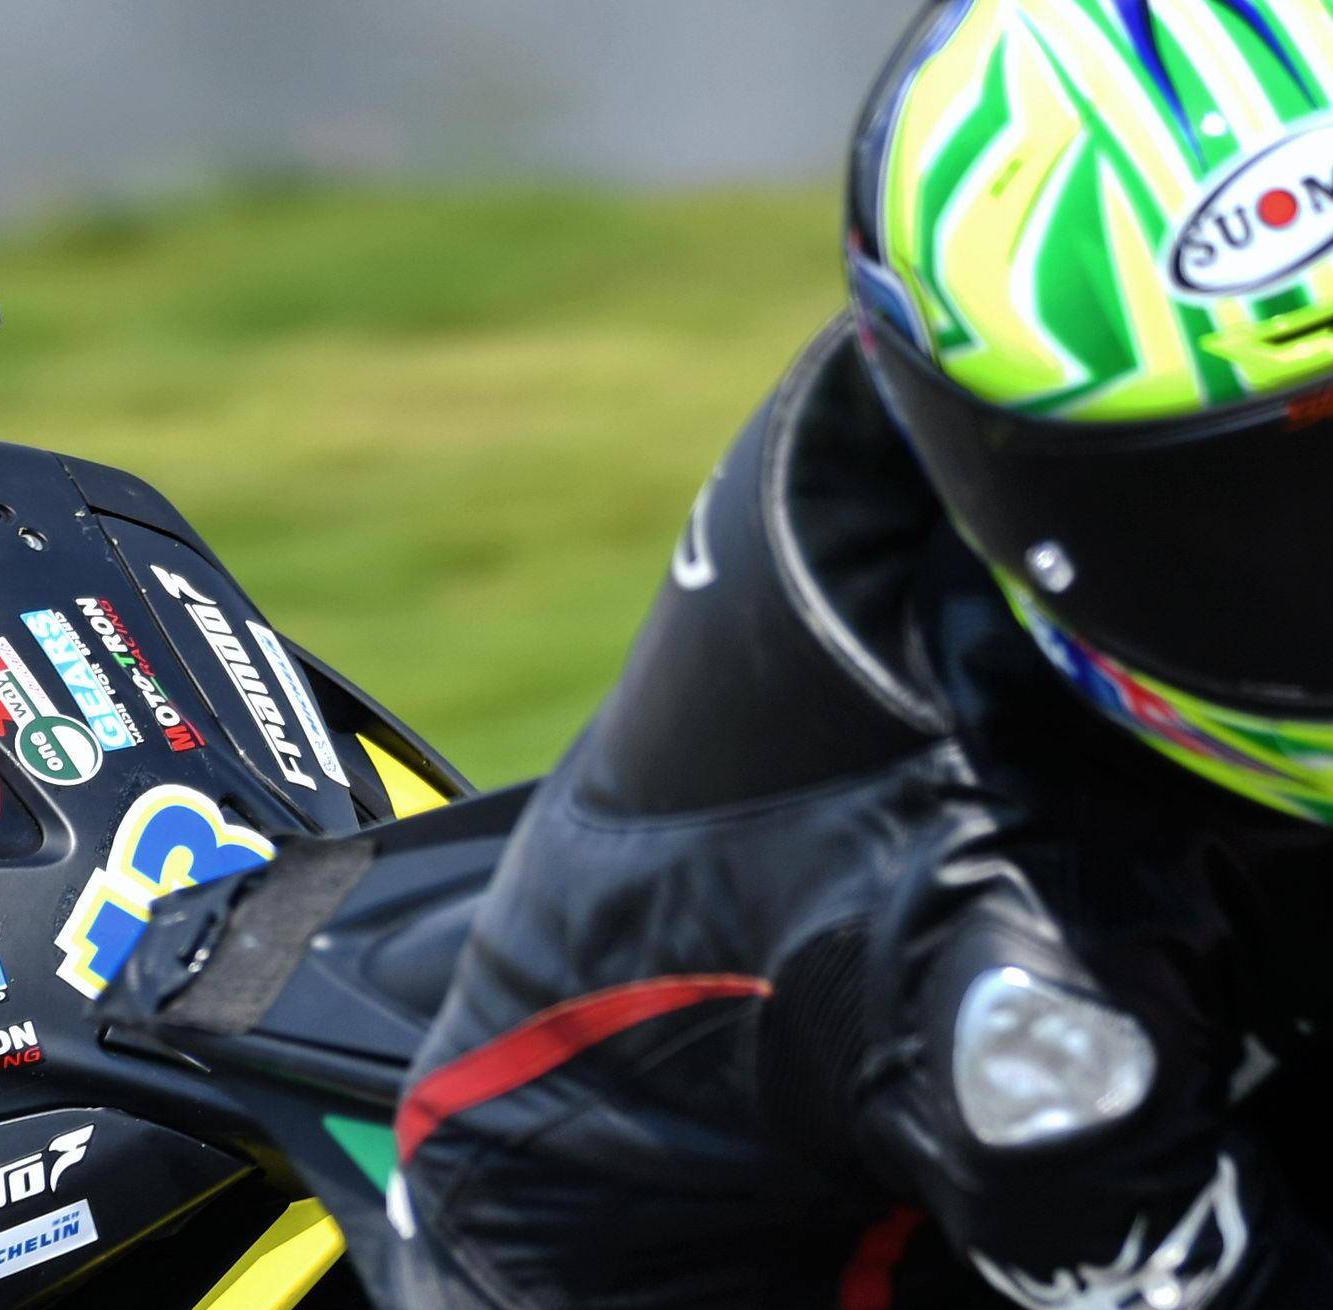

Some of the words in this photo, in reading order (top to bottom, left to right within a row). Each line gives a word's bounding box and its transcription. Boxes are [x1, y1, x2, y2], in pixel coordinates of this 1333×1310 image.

[26, 612, 128, 746] GEARS
[75, 597, 196, 752] MOTO-TRON
[30, 731, 64, 771] one
